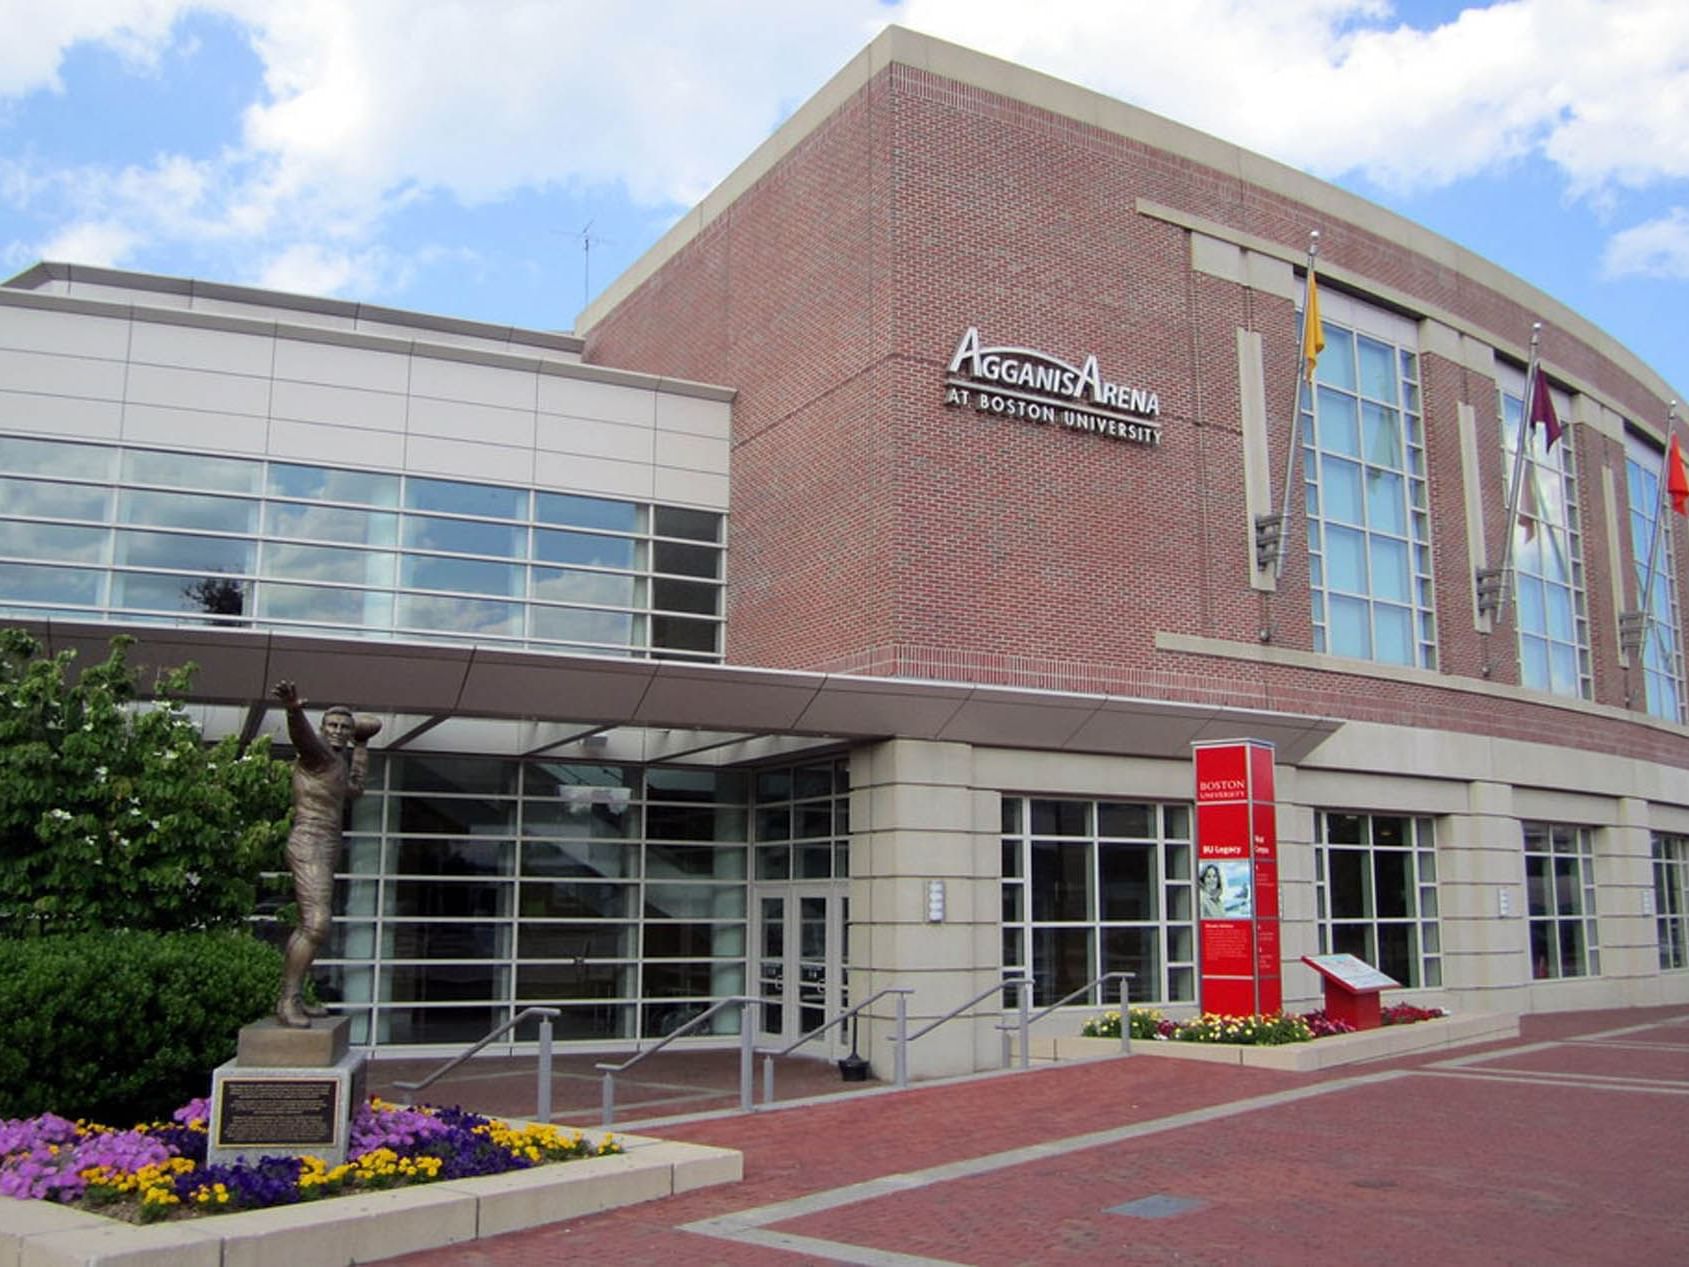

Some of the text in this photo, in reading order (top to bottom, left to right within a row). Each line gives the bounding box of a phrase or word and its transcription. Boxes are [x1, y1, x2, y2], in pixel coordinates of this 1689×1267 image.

[949, 326, 1160, 416] AGGANIS ARENA
[948, 388, 1163, 445] AT BOSTON UNIVERSITY
[1199, 780, 1245, 791] BOSTON
[1199, 791, 1245, 799] UNIVERSITY
[1214, 845, 1242, 855] Legacy
